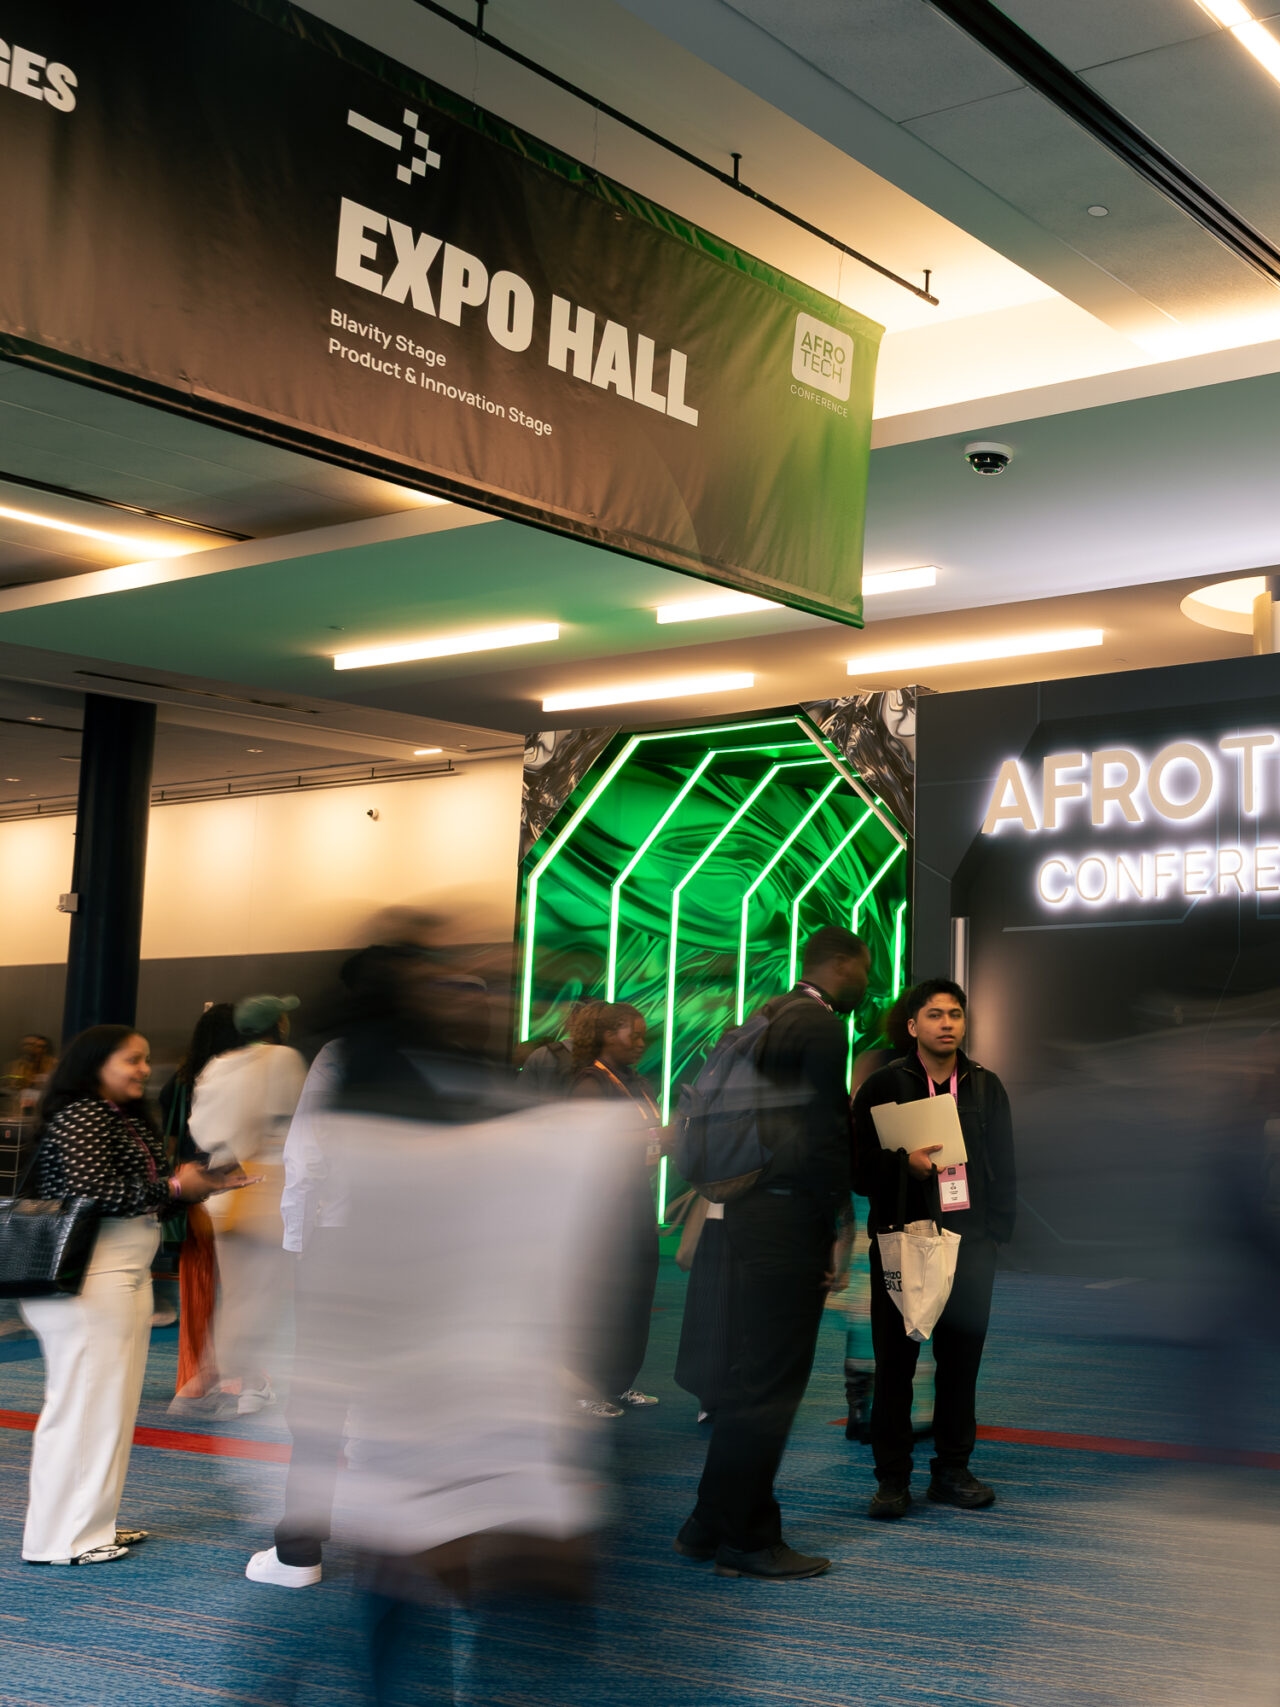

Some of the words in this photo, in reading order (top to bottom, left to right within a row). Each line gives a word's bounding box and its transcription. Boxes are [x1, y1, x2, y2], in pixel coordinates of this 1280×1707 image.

[335, 196, 535, 353] EXPO
[548, 293, 699, 427] HALL
[330, 308, 392, 350] Blavity
[395, 335, 447, 368] Stage
[801, 330, 846, 365] AFRO
[328, 337, 402, 380] Product
[404, 367, 417, 385] &
[420, 372, 505, 418] Innovation
[508, 406, 552, 436] Stage
[800, 347, 843, 384] TECH
[790, 384, 848, 418] CONFERENCE
